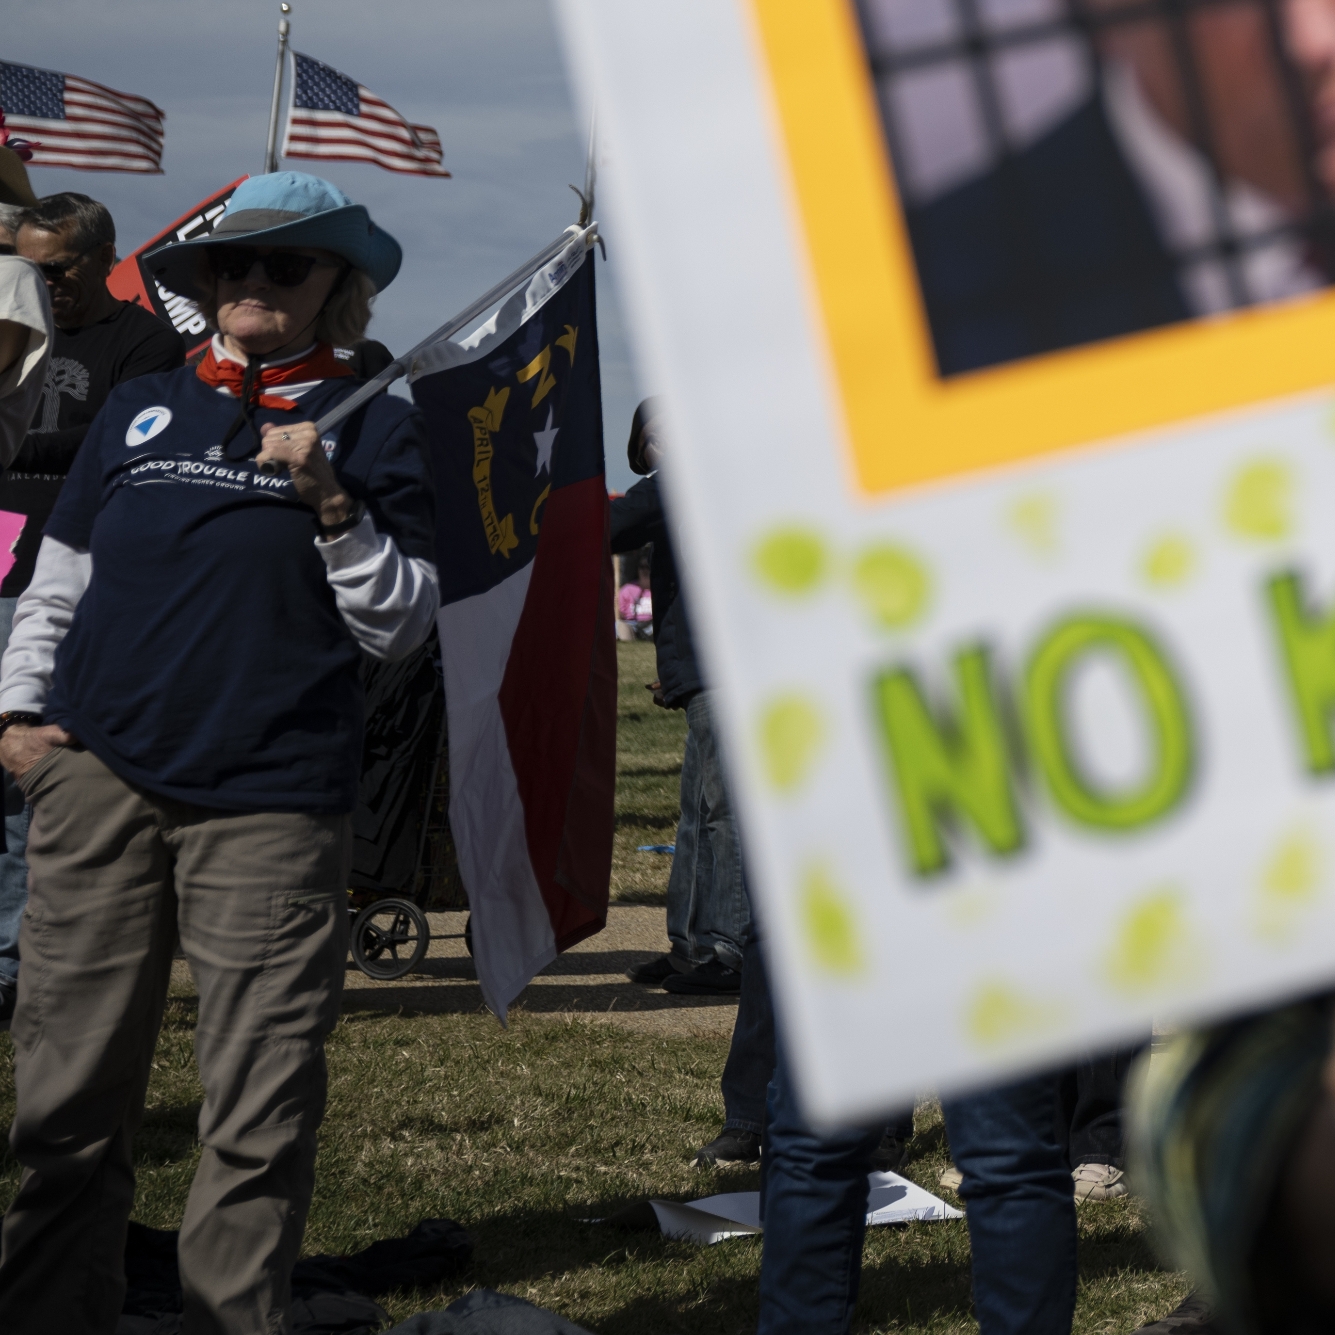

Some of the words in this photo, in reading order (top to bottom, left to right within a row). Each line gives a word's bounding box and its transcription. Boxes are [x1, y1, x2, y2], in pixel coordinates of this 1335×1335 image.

[470, 417, 492, 468] APRIL
[177, 460, 250, 483] TROUBLE
[215, 480, 246, 491] GROUND
[868, 611, 1196, 886] NO
